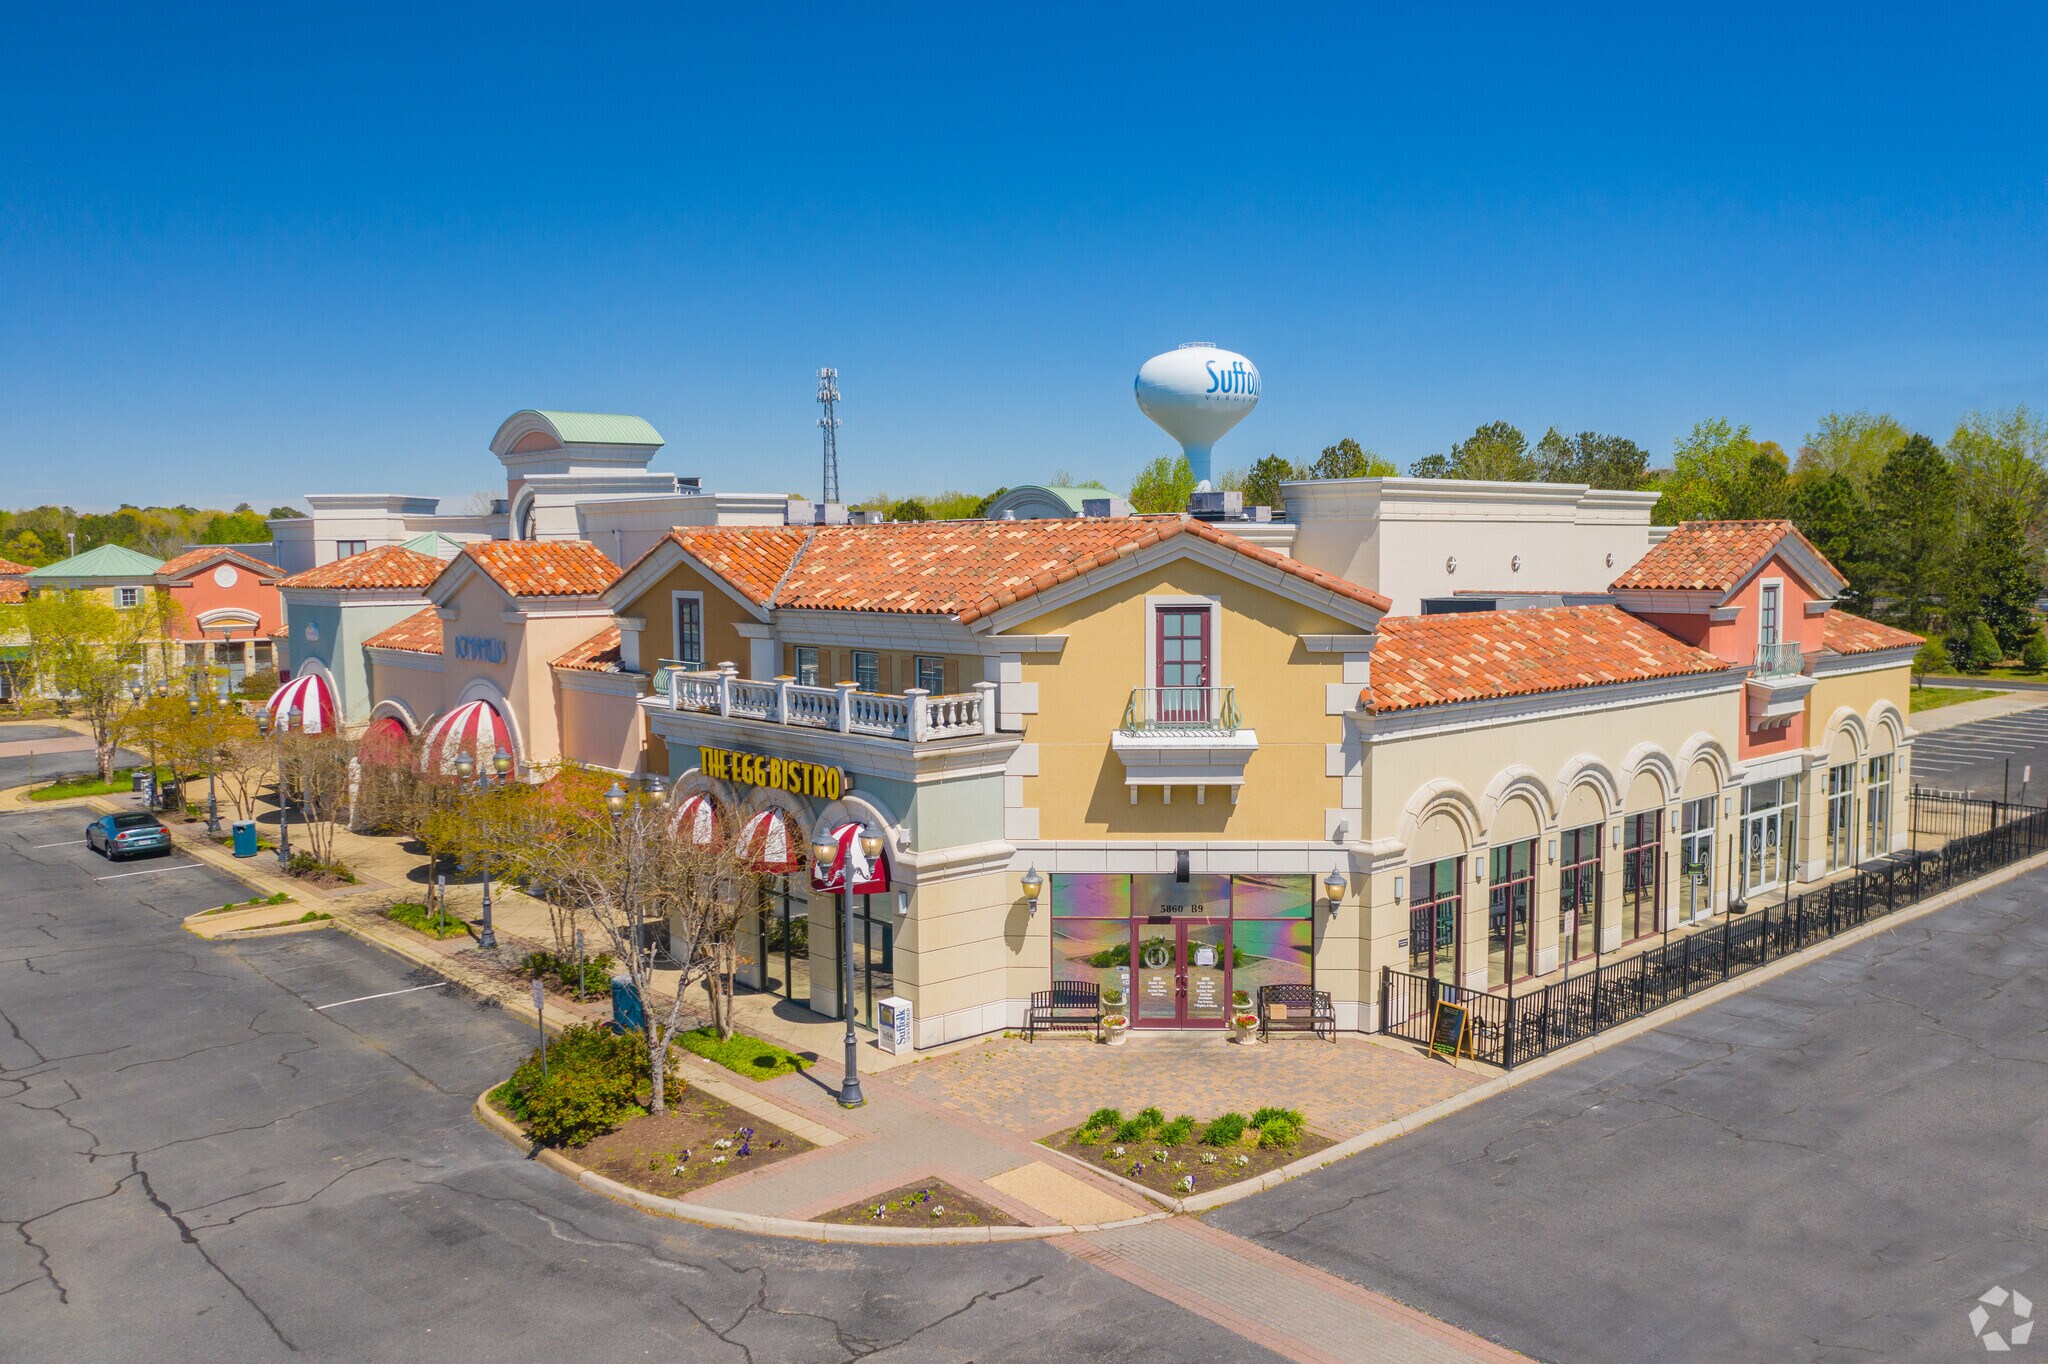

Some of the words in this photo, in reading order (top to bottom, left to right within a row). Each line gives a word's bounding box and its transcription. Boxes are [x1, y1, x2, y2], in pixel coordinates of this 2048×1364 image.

[1205, 360, 1260, 396] Suffol
[698, 745, 730, 780] THE
[731, 751, 767, 788] EGG
[769, 757, 841, 801] BISTRO
[1160, 904, 1184, 913] 5860
[1191, 904, 1204, 913] B9
[896, 1009, 906, 1045] Suffolk
